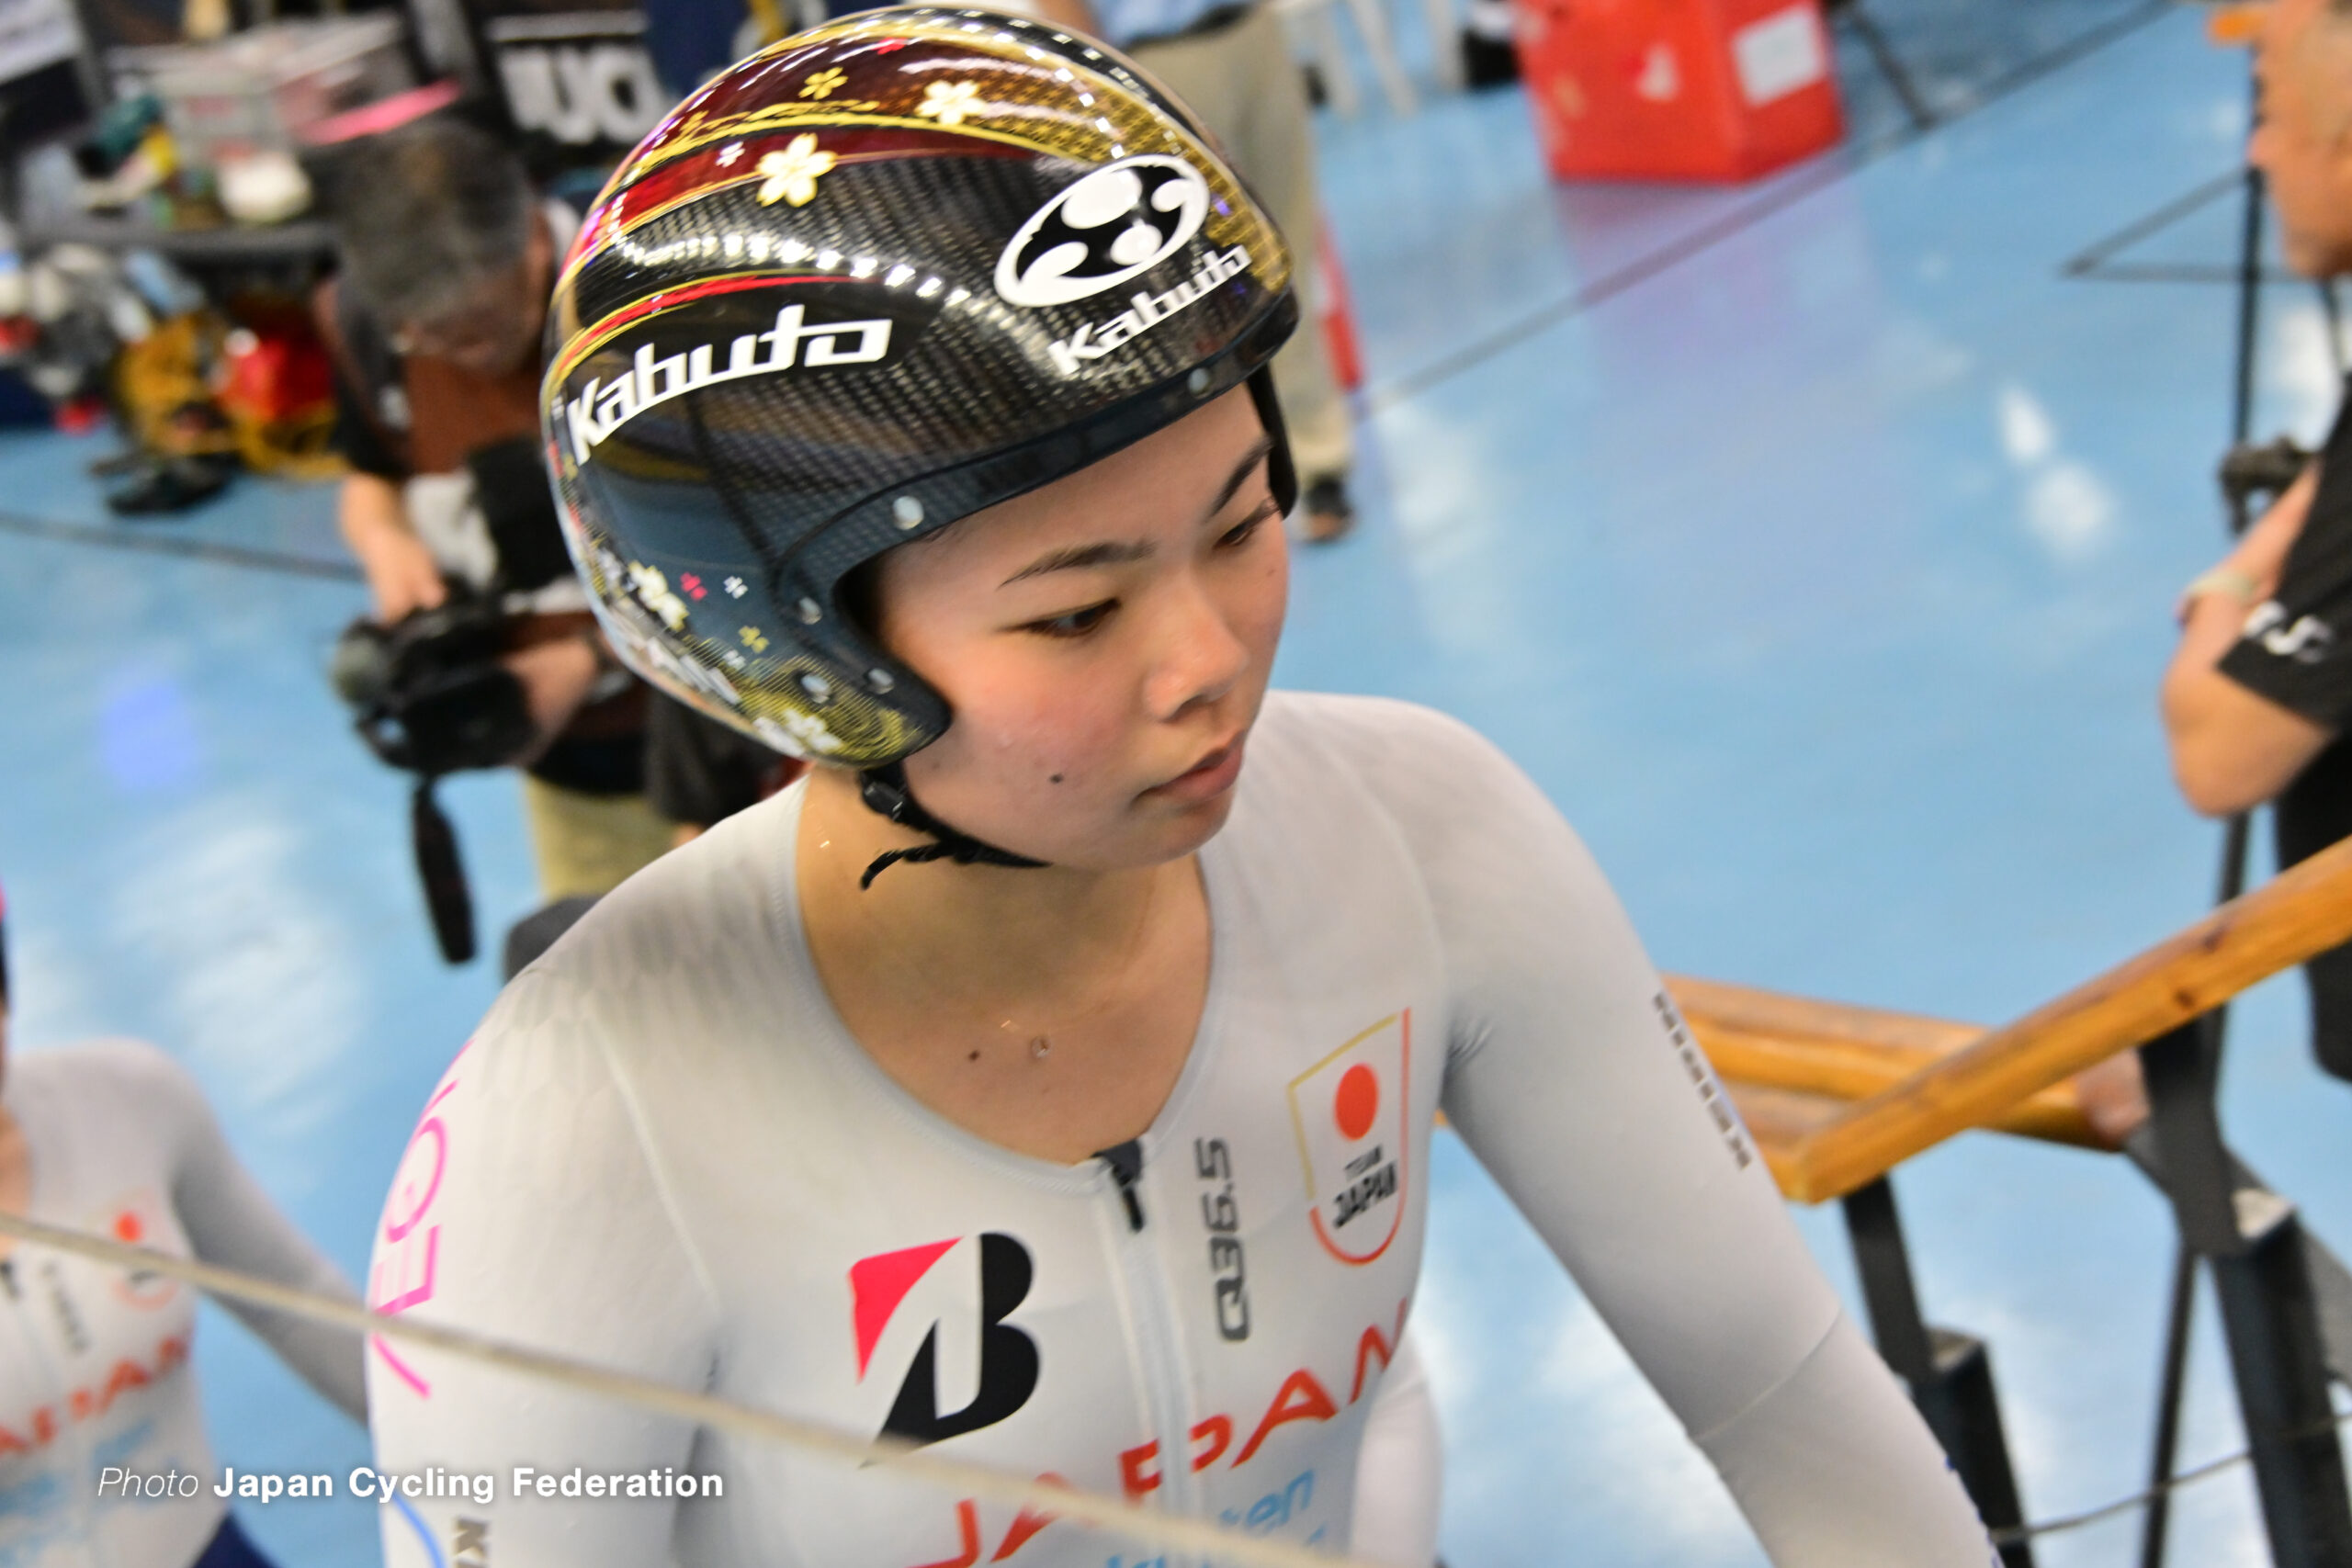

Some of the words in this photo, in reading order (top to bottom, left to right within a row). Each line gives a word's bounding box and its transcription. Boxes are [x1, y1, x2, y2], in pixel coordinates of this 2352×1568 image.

[1047, 244, 1252, 375] Kabuto
[567, 304, 893, 466] Kabuto
[1193, 1138, 1250, 1342] Q36.5
[1332, 1158, 1399, 1229] JAPAN
